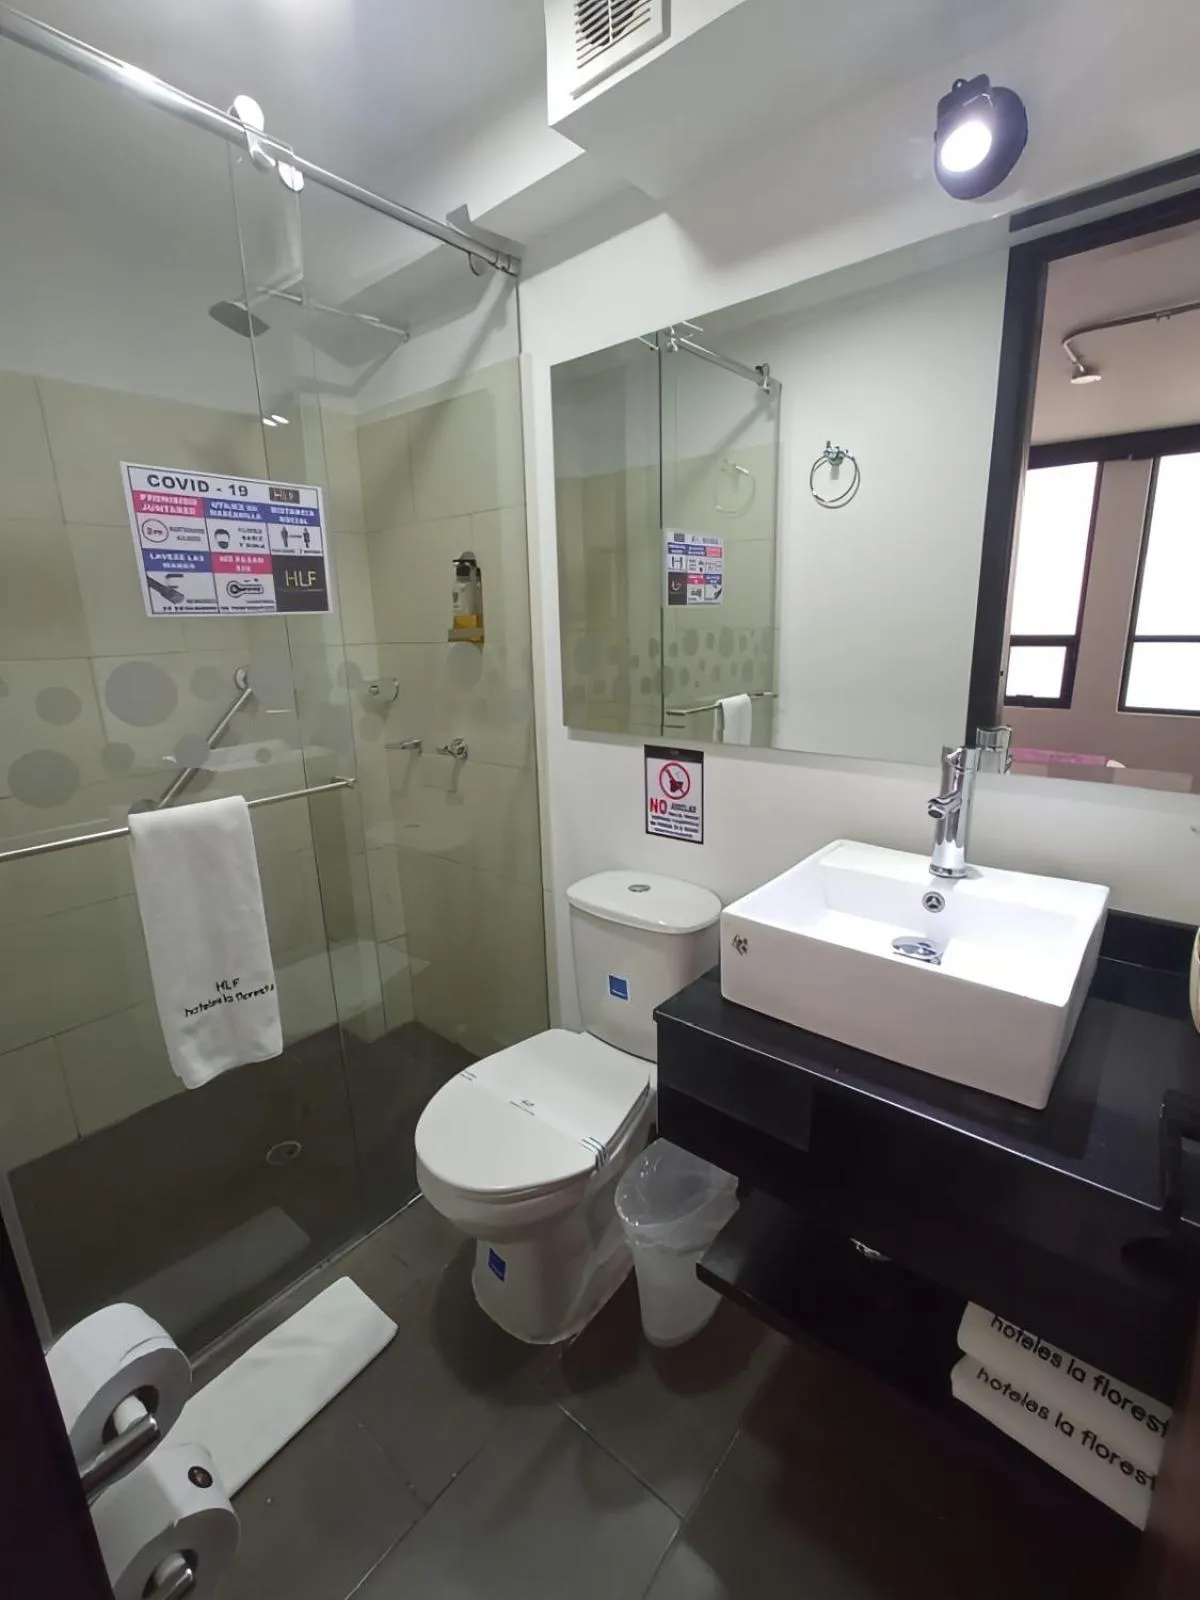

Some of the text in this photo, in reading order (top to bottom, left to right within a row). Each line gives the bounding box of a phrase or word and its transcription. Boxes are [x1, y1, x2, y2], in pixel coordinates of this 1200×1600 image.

[147, 474, 210, 493] COVID
[228, 484, 249, 497] 19
[284, 569, 317, 588] HLF
[650, 797, 668, 815] NO
[990, 1314, 1063, 1368] hoteles
[1066, 1359, 1087, 1384] la
[976, 1367, 1050, 1421] hoteles
[1055, 1412, 1075, 1438] la
